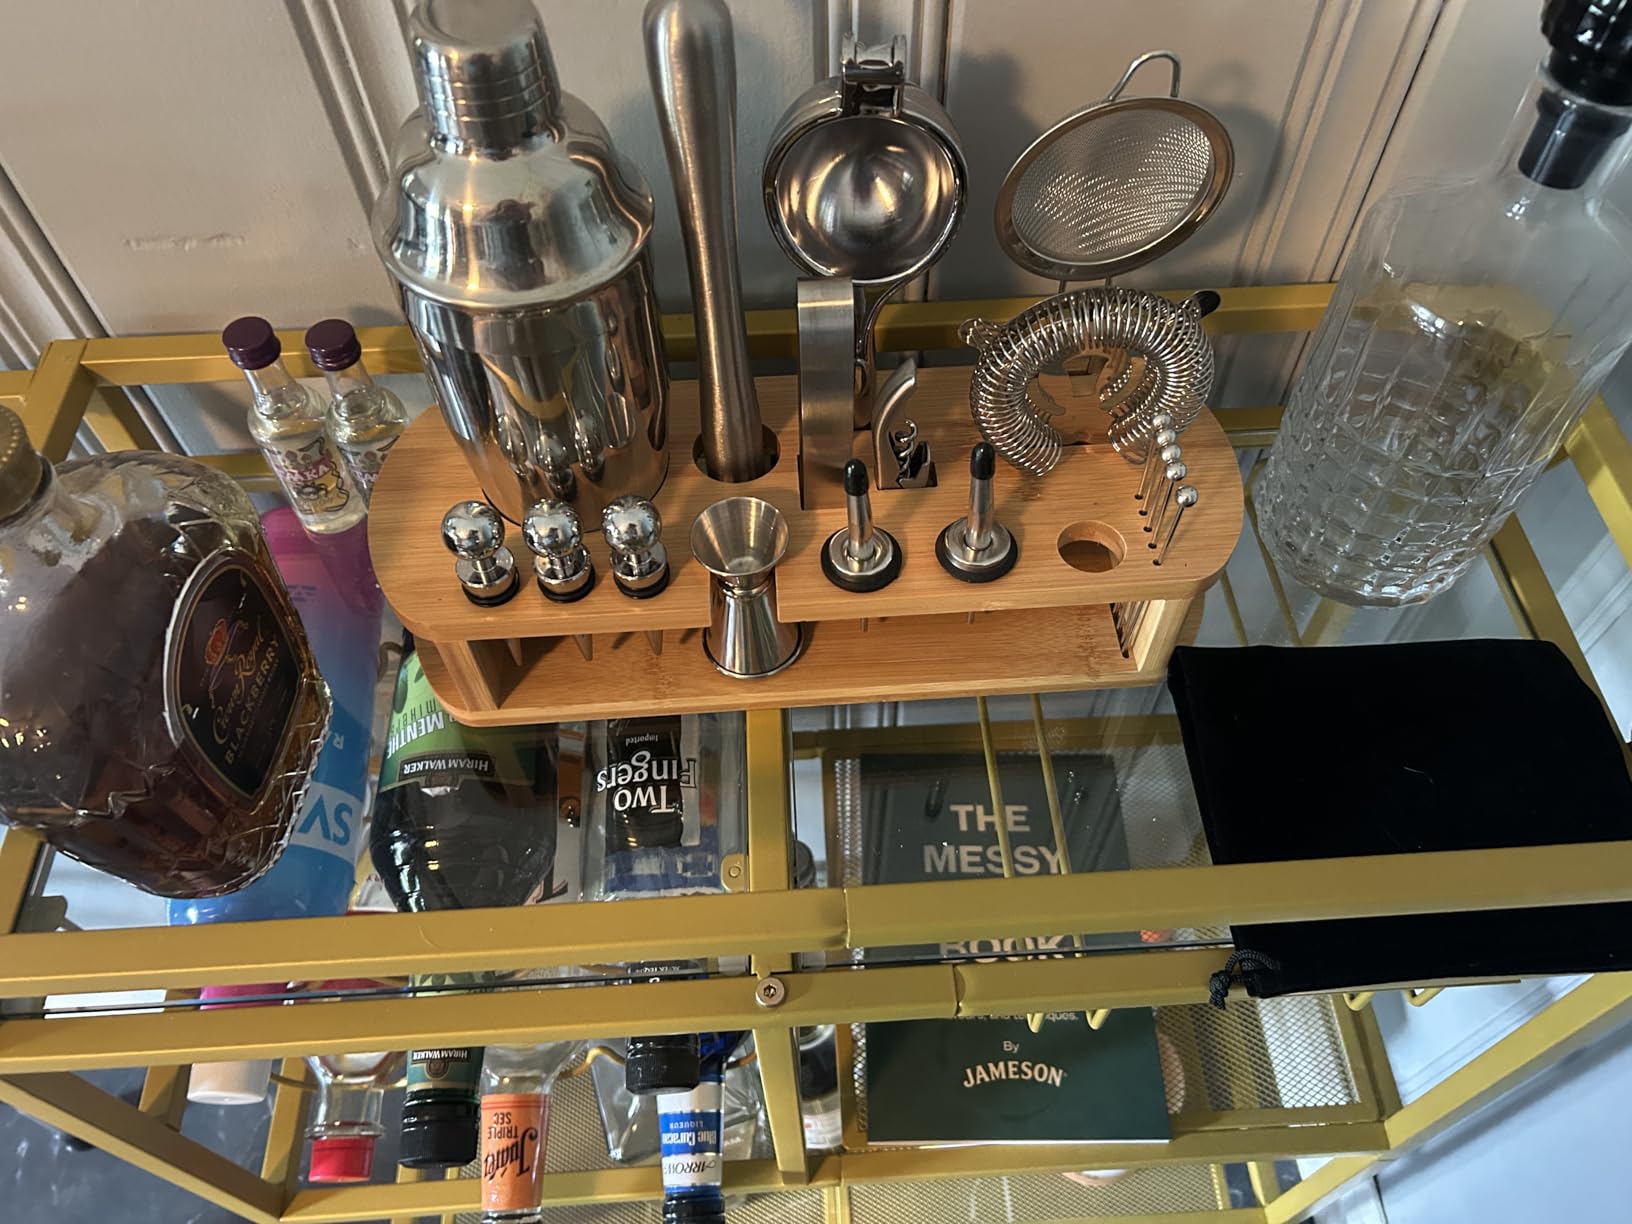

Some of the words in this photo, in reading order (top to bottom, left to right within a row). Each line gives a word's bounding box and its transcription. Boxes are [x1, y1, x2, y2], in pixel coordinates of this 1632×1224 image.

[224, 635, 279, 766] BLACKBERRY
[386, 711, 445, 760] MENTHE
[625, 734, 659, 747] Imported
[403, 759, 447, 775] WALKER
[448, 758, 489, 772] HIRAM
[595, 750, 697, 792] Fingers
[949, 804, 1030, 833] THE
[923, 844, 1063, 874] MESSY
[440, 1049, 468, 1060] HIRAM
[1002, 1040, 1021, 1054] By
[412, 1050, 440, 1061] WALKER
[962, 1060, 1065, 1089] JAMESON
[492, 1111, 513, 1125] SEC
[668, 1120, 704, 1130] LIQUEUR
[487, 1125, 520, 1140] TRIPLE
[696, 1130, 717, 1145] Blue
[663, 1160, 717, 1175] ARROW
